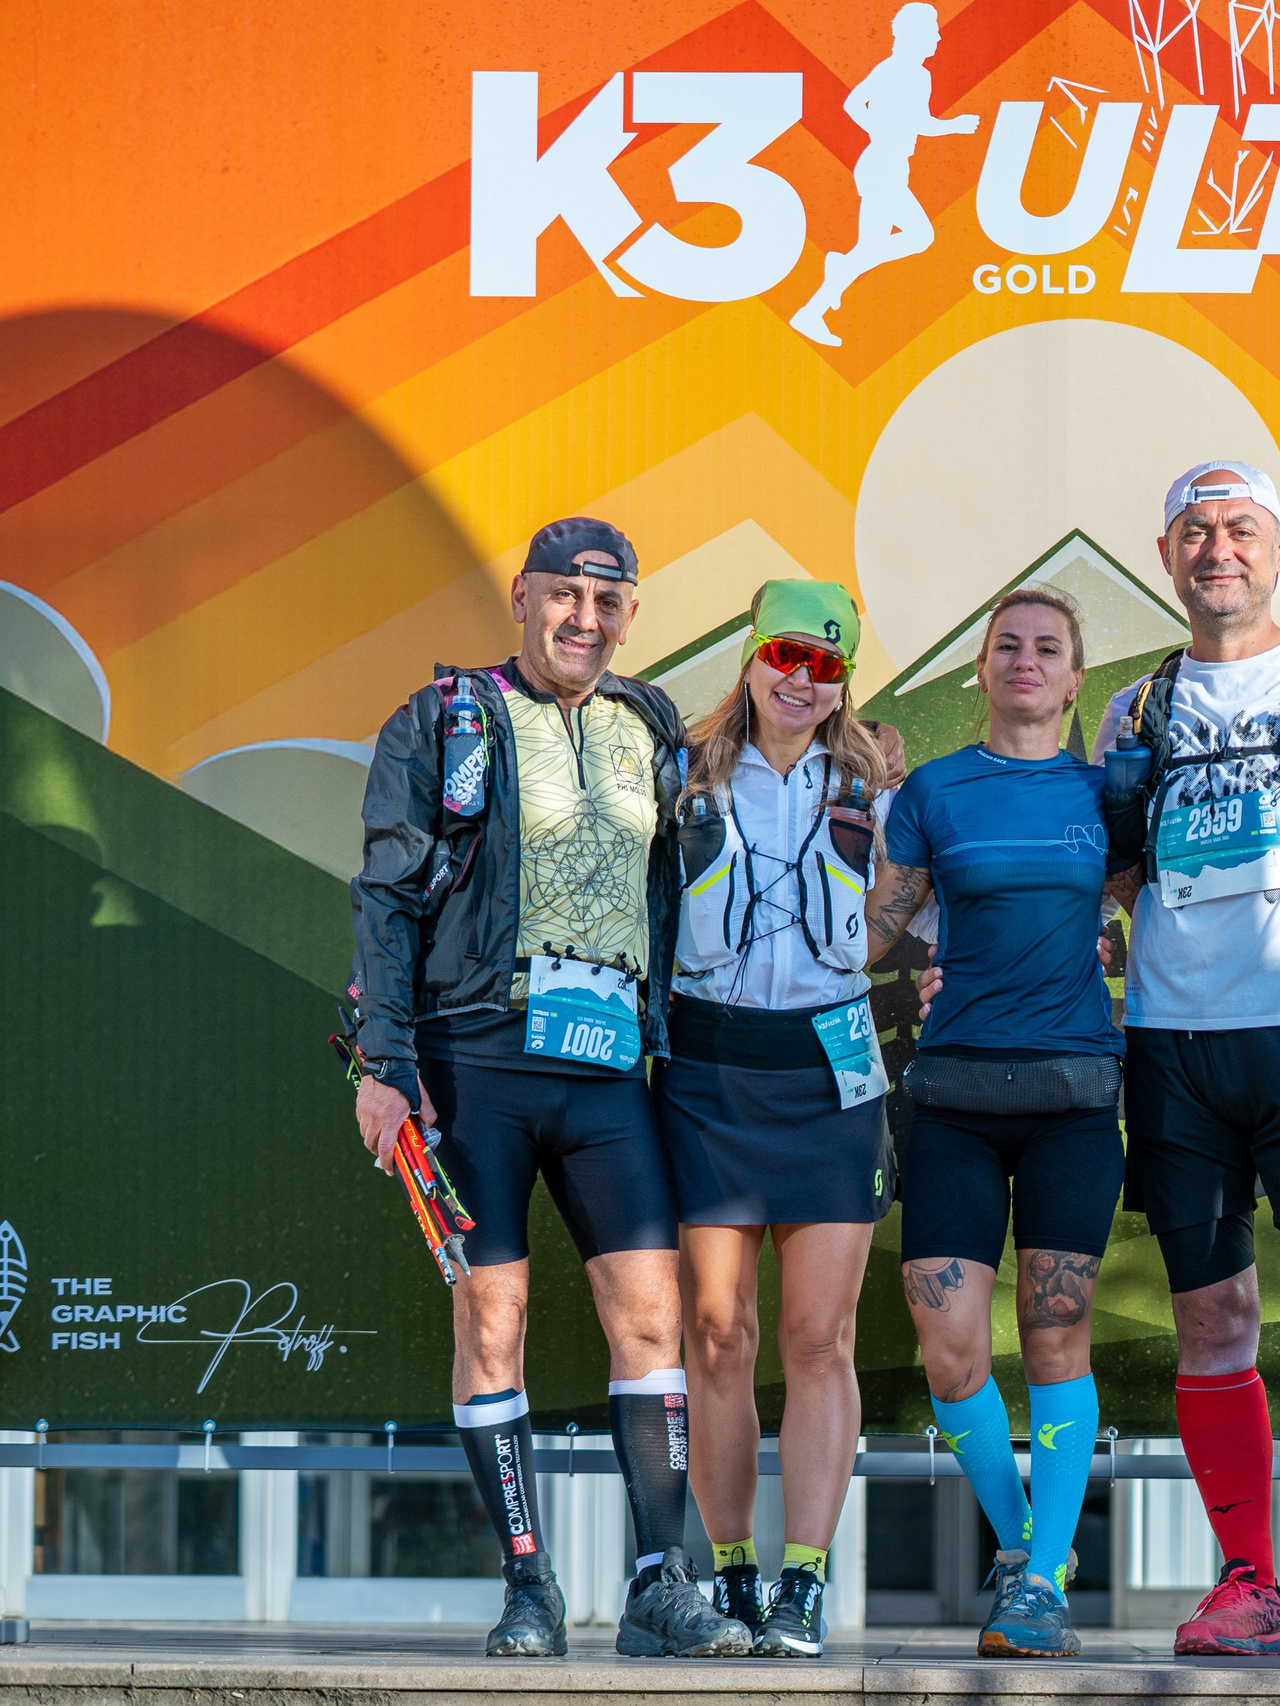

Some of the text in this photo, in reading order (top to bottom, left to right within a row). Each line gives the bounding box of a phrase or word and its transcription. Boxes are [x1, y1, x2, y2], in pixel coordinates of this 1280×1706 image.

[470, 71, 807, 298] K3
[973, 266, 1097, 295] GOLD
[1185, 798, 1243, 843] 2359
[1178, 885, 1193, 900] 23K
[847, 1002, 873, 1042] 23
[560, 1022, 617, 1061] 2001
[854, 1083, 867, 1099] 23K
[51, 1278, 112, 1296] THE
[51, 1305, 188, 1324] GRAPHIC
[51, 1332, 121, 1350] FISH
